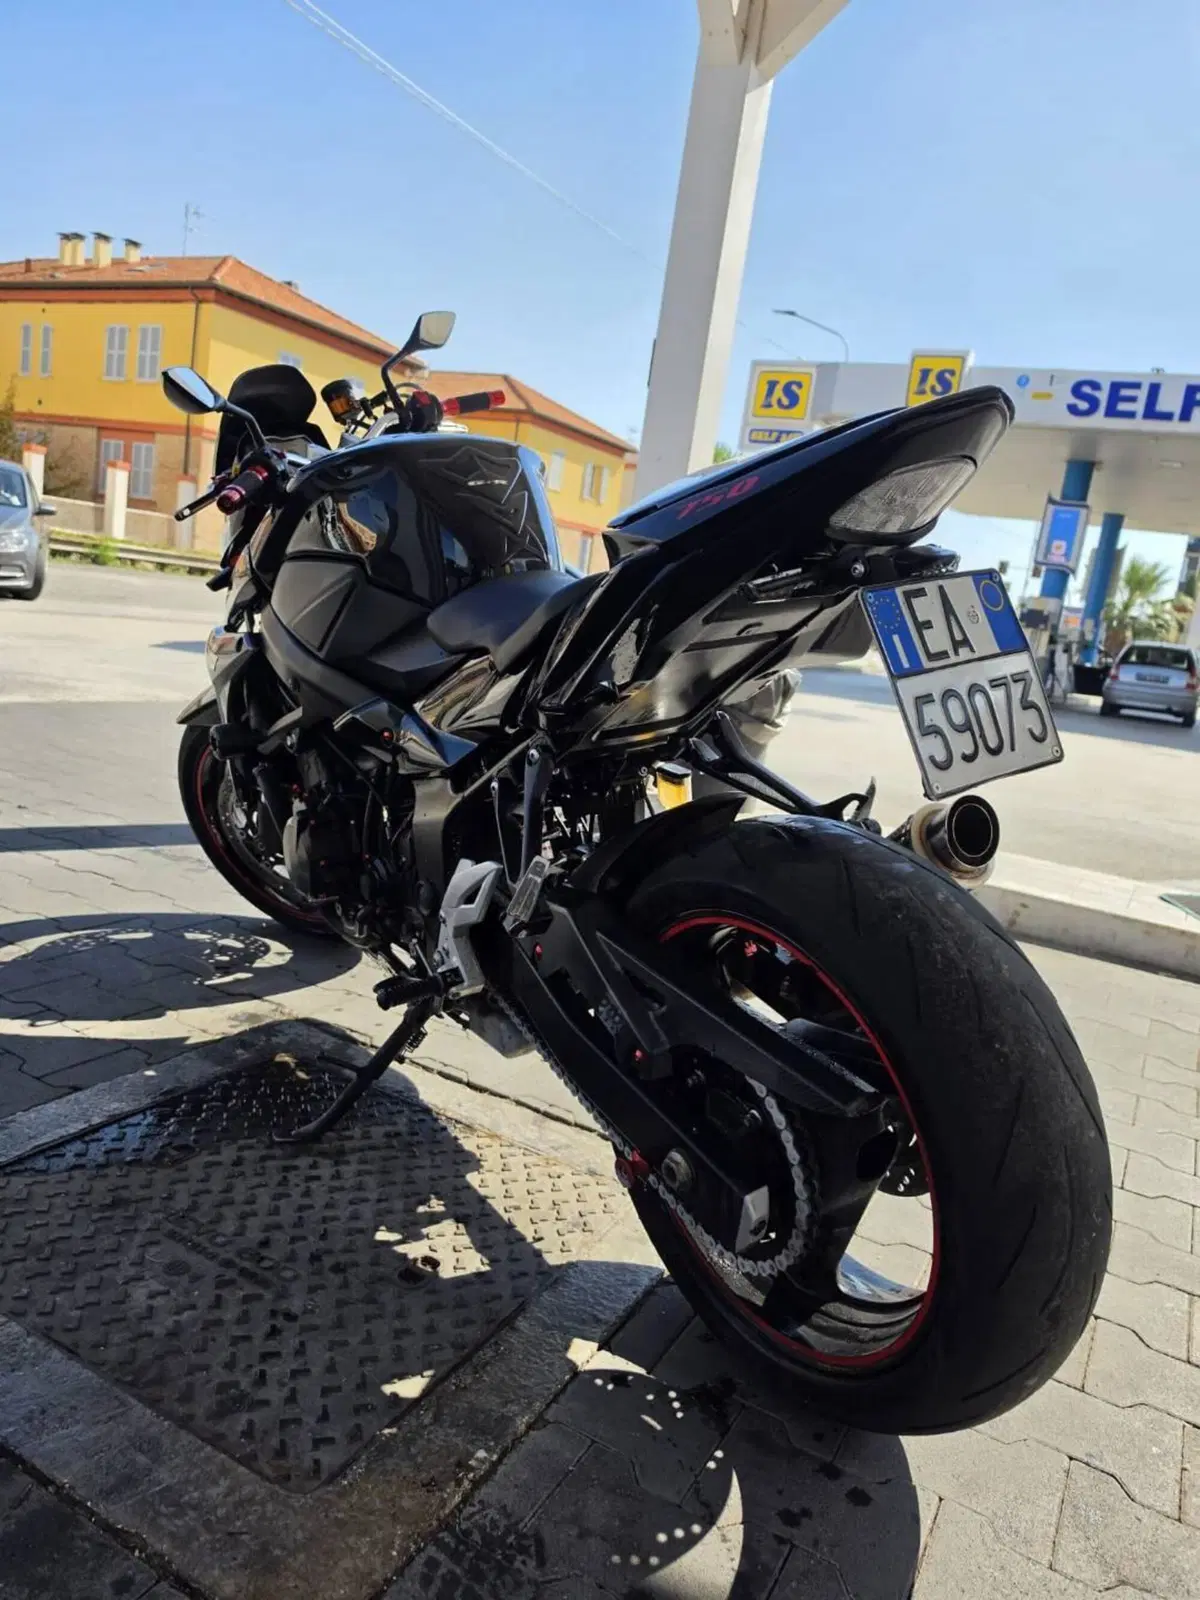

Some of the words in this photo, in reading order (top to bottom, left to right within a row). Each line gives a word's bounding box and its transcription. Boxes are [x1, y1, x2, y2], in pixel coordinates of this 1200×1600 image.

[760, 379, 803, 410] IS
[913, 368, 957, 396] IS
[902, 585, 976, 662] EA
[914, 670, 1048, 771] 59073
